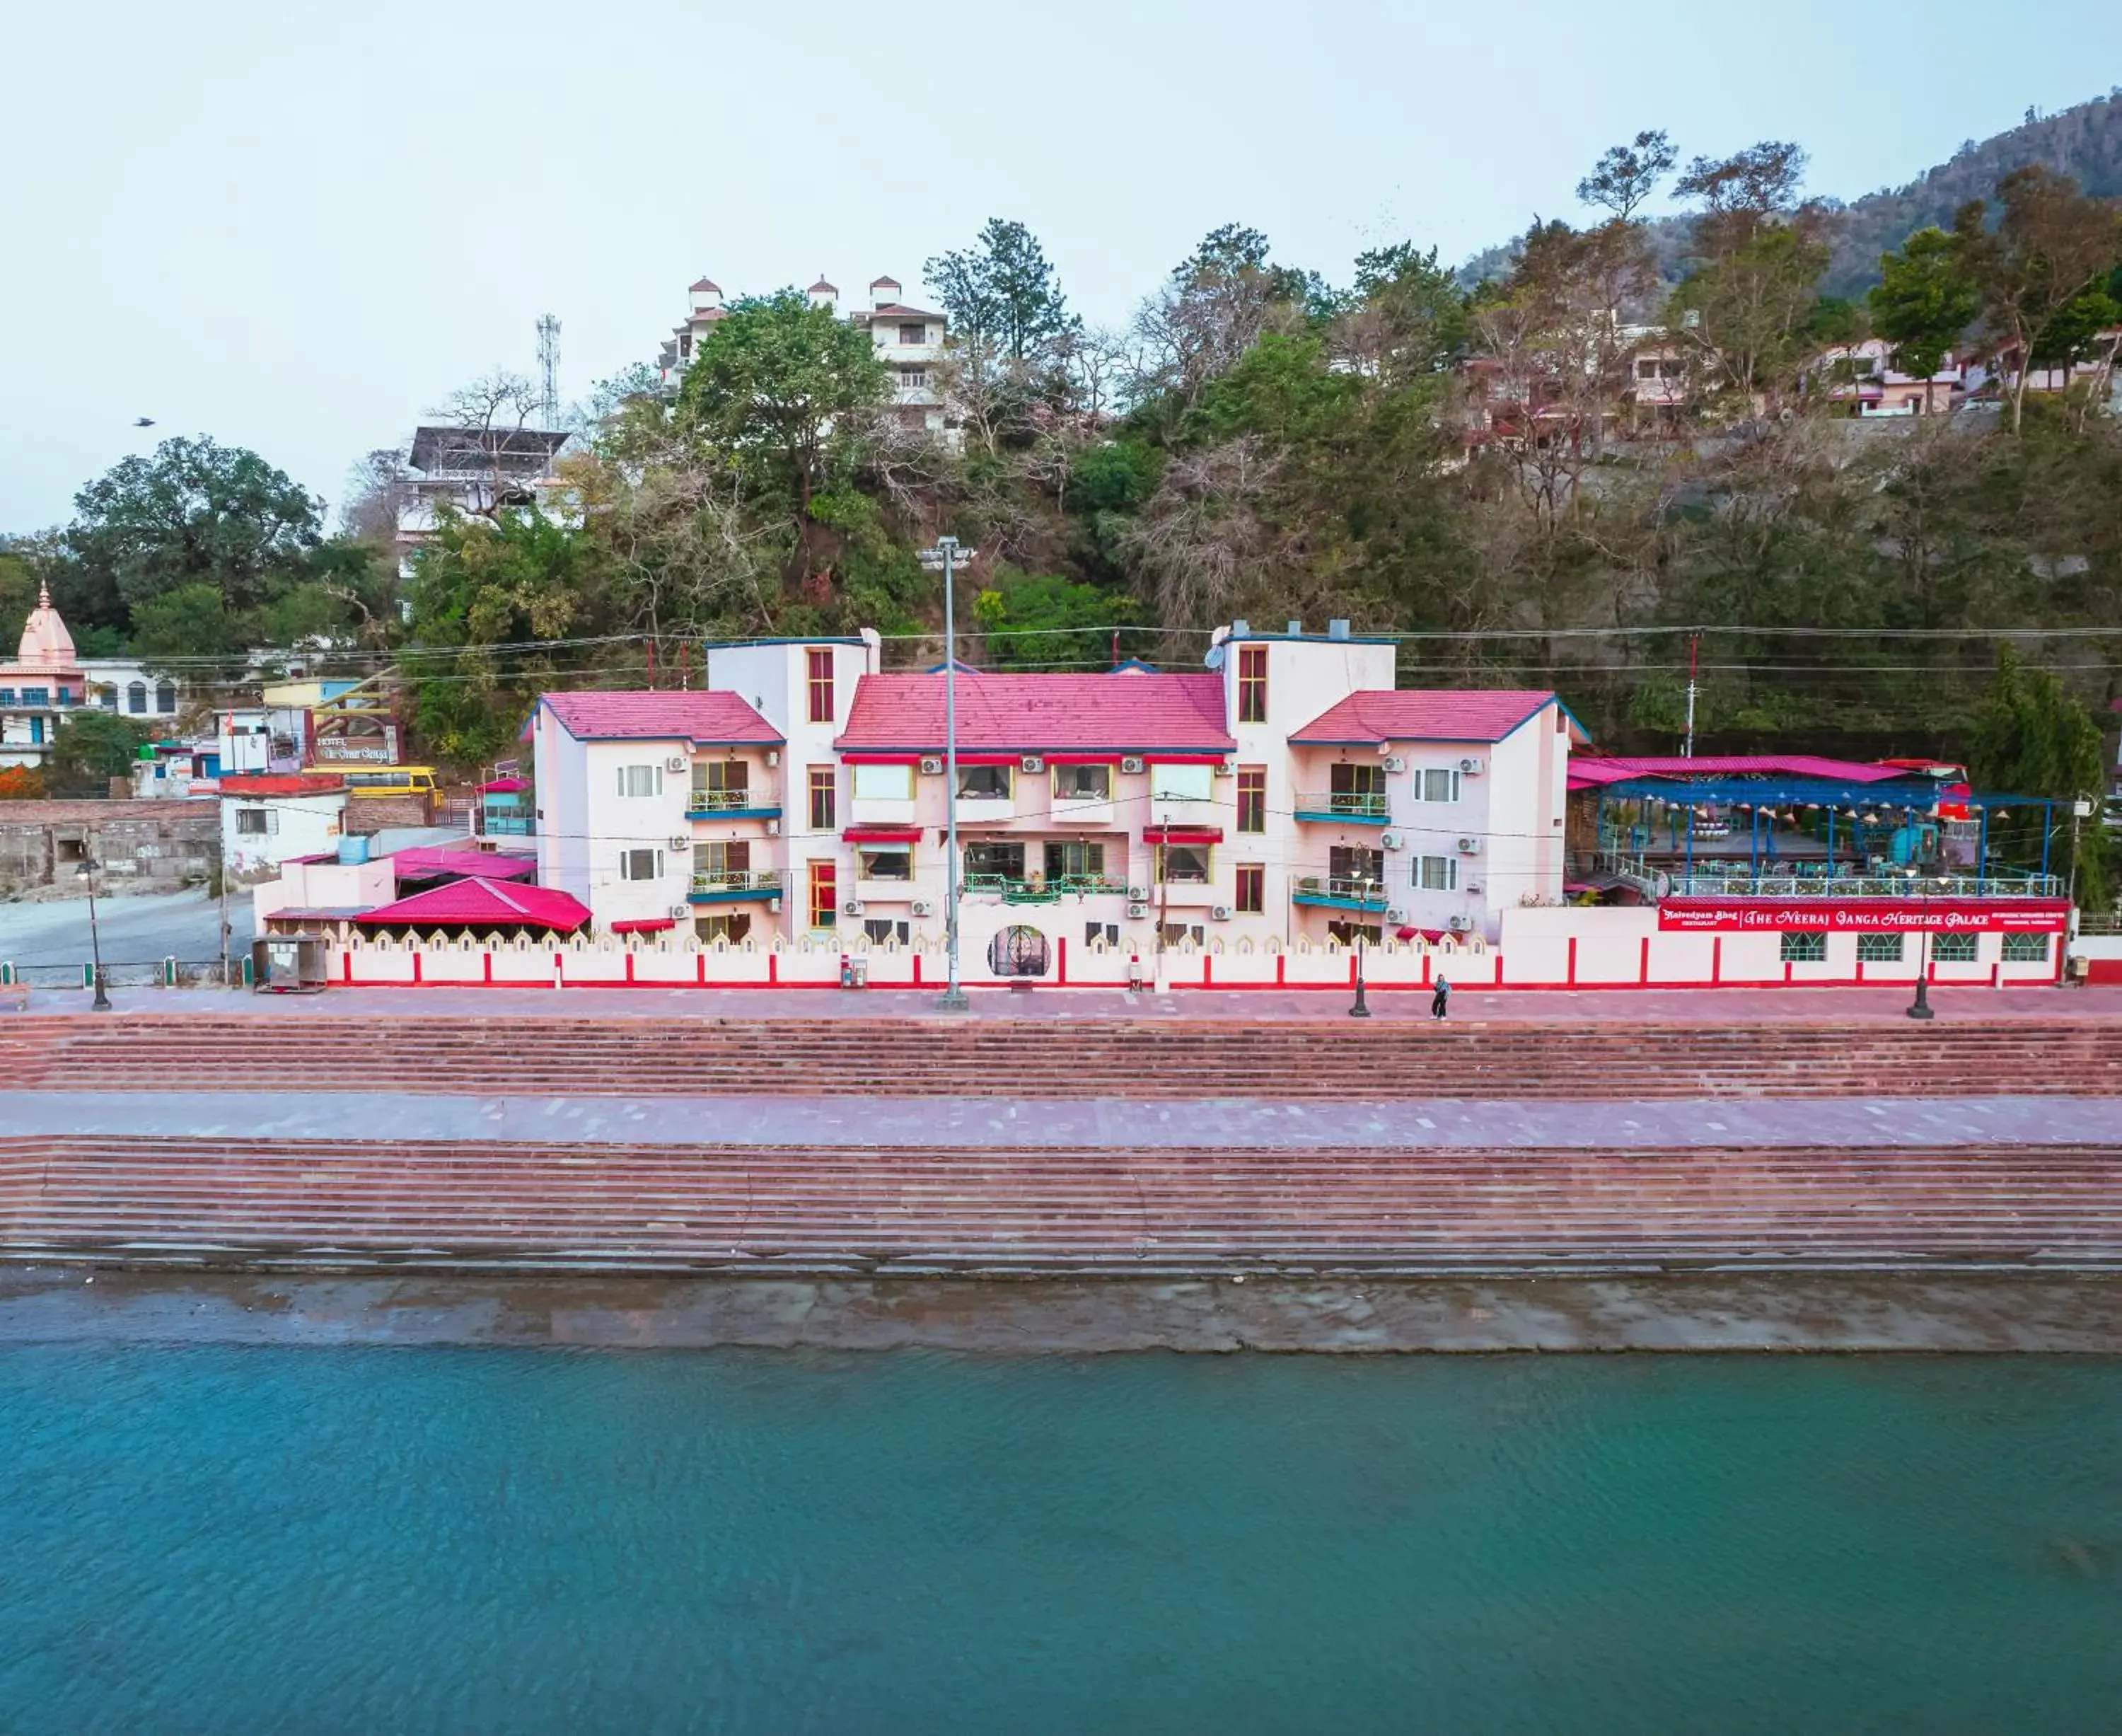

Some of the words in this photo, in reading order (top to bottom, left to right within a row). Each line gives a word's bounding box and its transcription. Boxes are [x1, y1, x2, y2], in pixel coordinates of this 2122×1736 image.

[317, 738, 347, 746] HOTEL
[1744, 910, 1772, 925] THE
[1775, 910, 1830, 926] NEERAJ
[1836, 910, 1879, 925] GANGA
[1881, 910, 1944, 926] HERITAGE
[1946, 912, 1989, 927] PALACE
